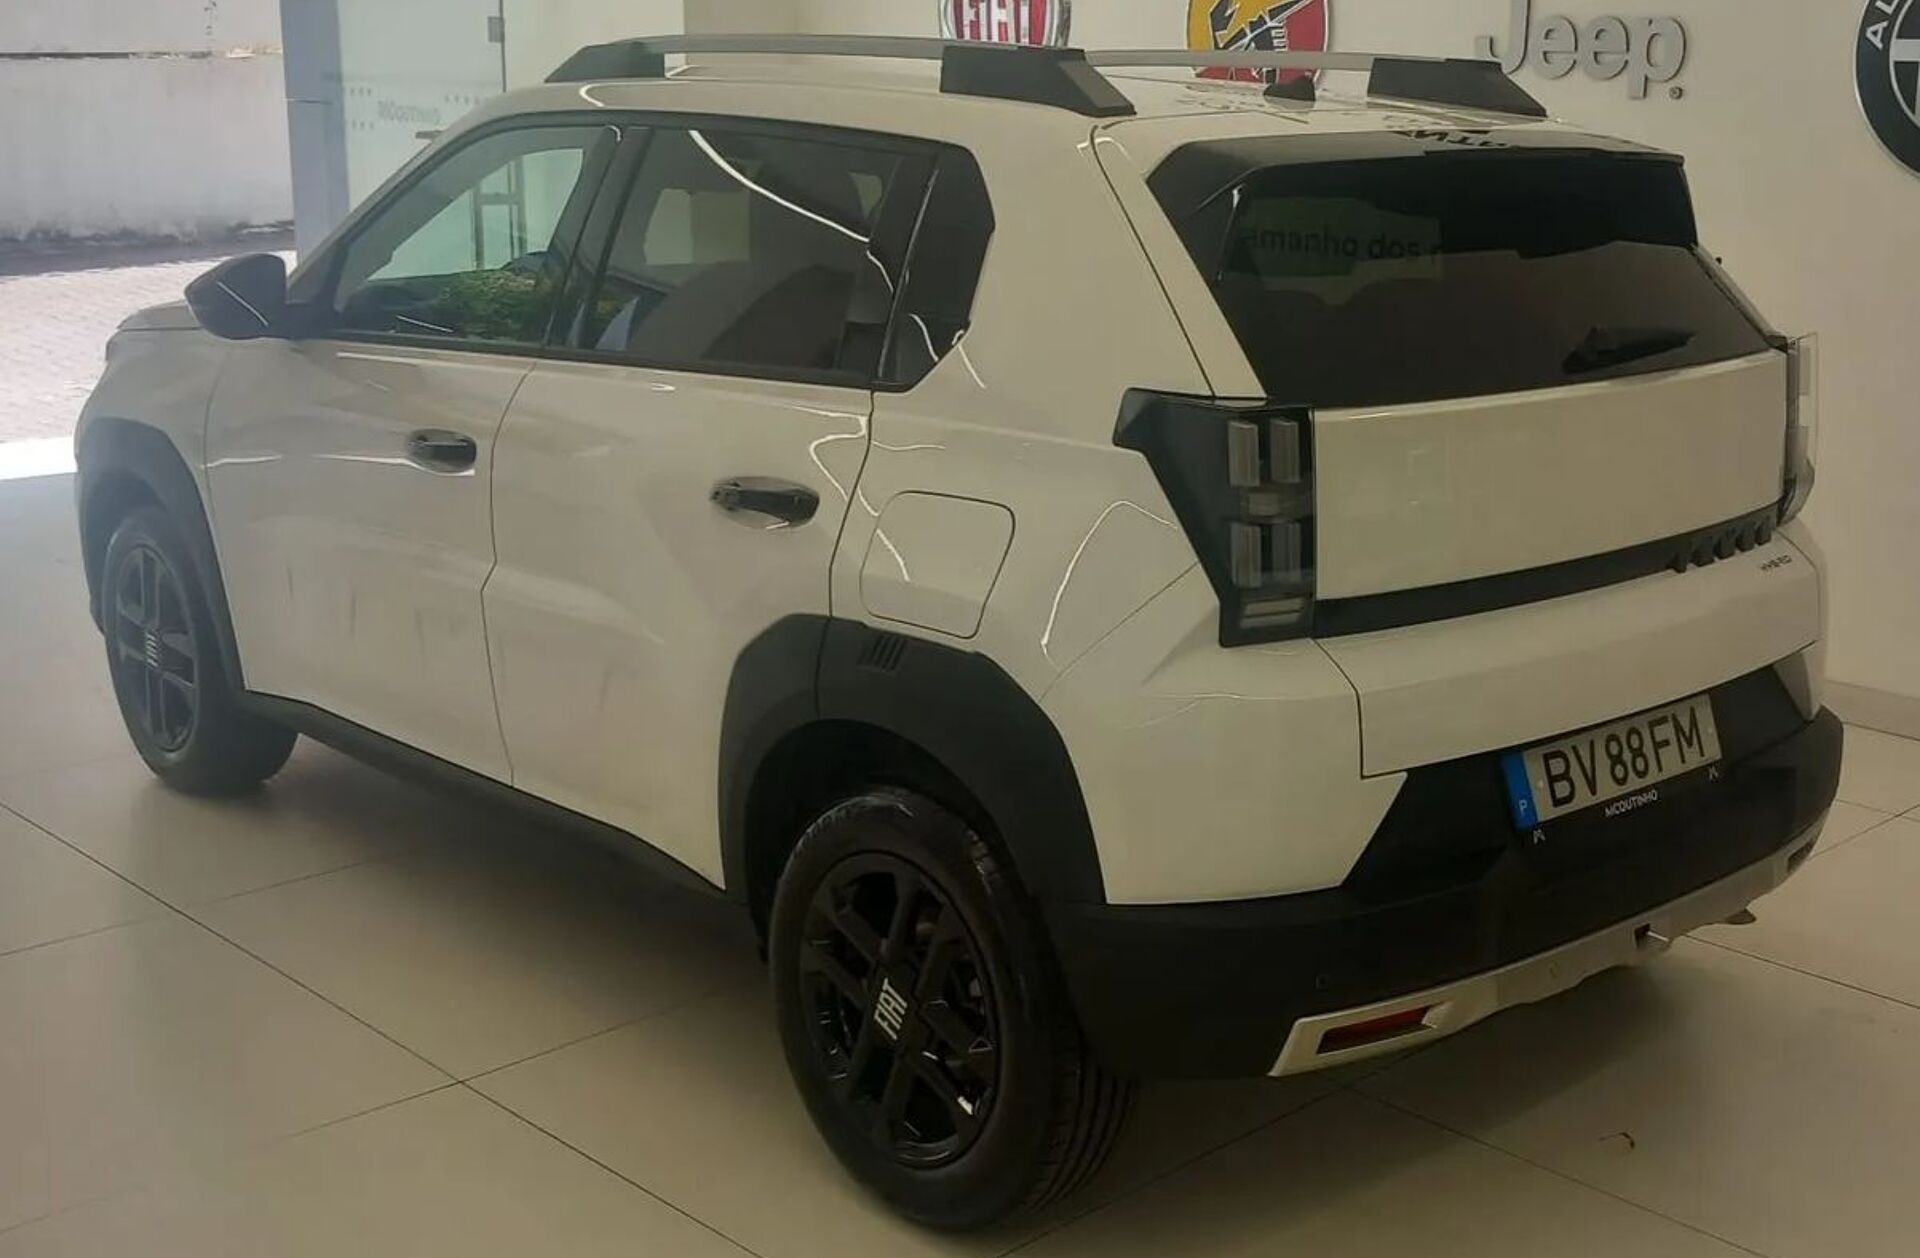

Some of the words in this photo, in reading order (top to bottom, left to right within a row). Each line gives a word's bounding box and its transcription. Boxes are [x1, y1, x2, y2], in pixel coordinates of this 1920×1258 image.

[1475, 0, 1687, 99] Jeep
[1518, 798, 1528, 812] P
[873, 977, 908, 1041] FIAT
